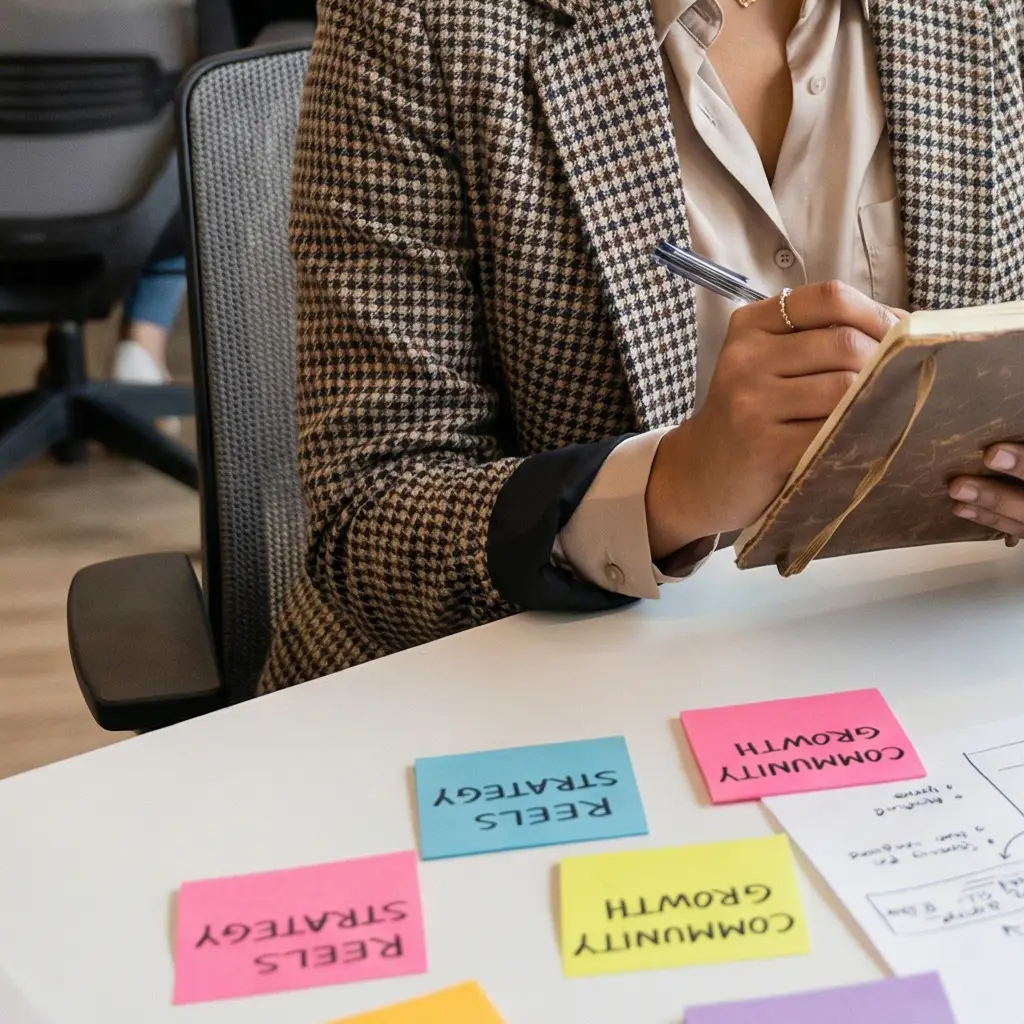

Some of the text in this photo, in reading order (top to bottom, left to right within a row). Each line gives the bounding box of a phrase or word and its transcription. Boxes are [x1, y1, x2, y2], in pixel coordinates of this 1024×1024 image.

[735, 726, 880, 757] GROWTH
[719, 746, 905, 783] COMMUNITY
[432, 770, 619, 808] STRATEGY
[473, 797, 613, 831] REELS
[604, 883, 772, 920] GROWTH
[195, 900, 408, 949] STRATEGY
[573, 912, 796, 957] COMMUNITY
[253, 934, 405, 975] REELS
